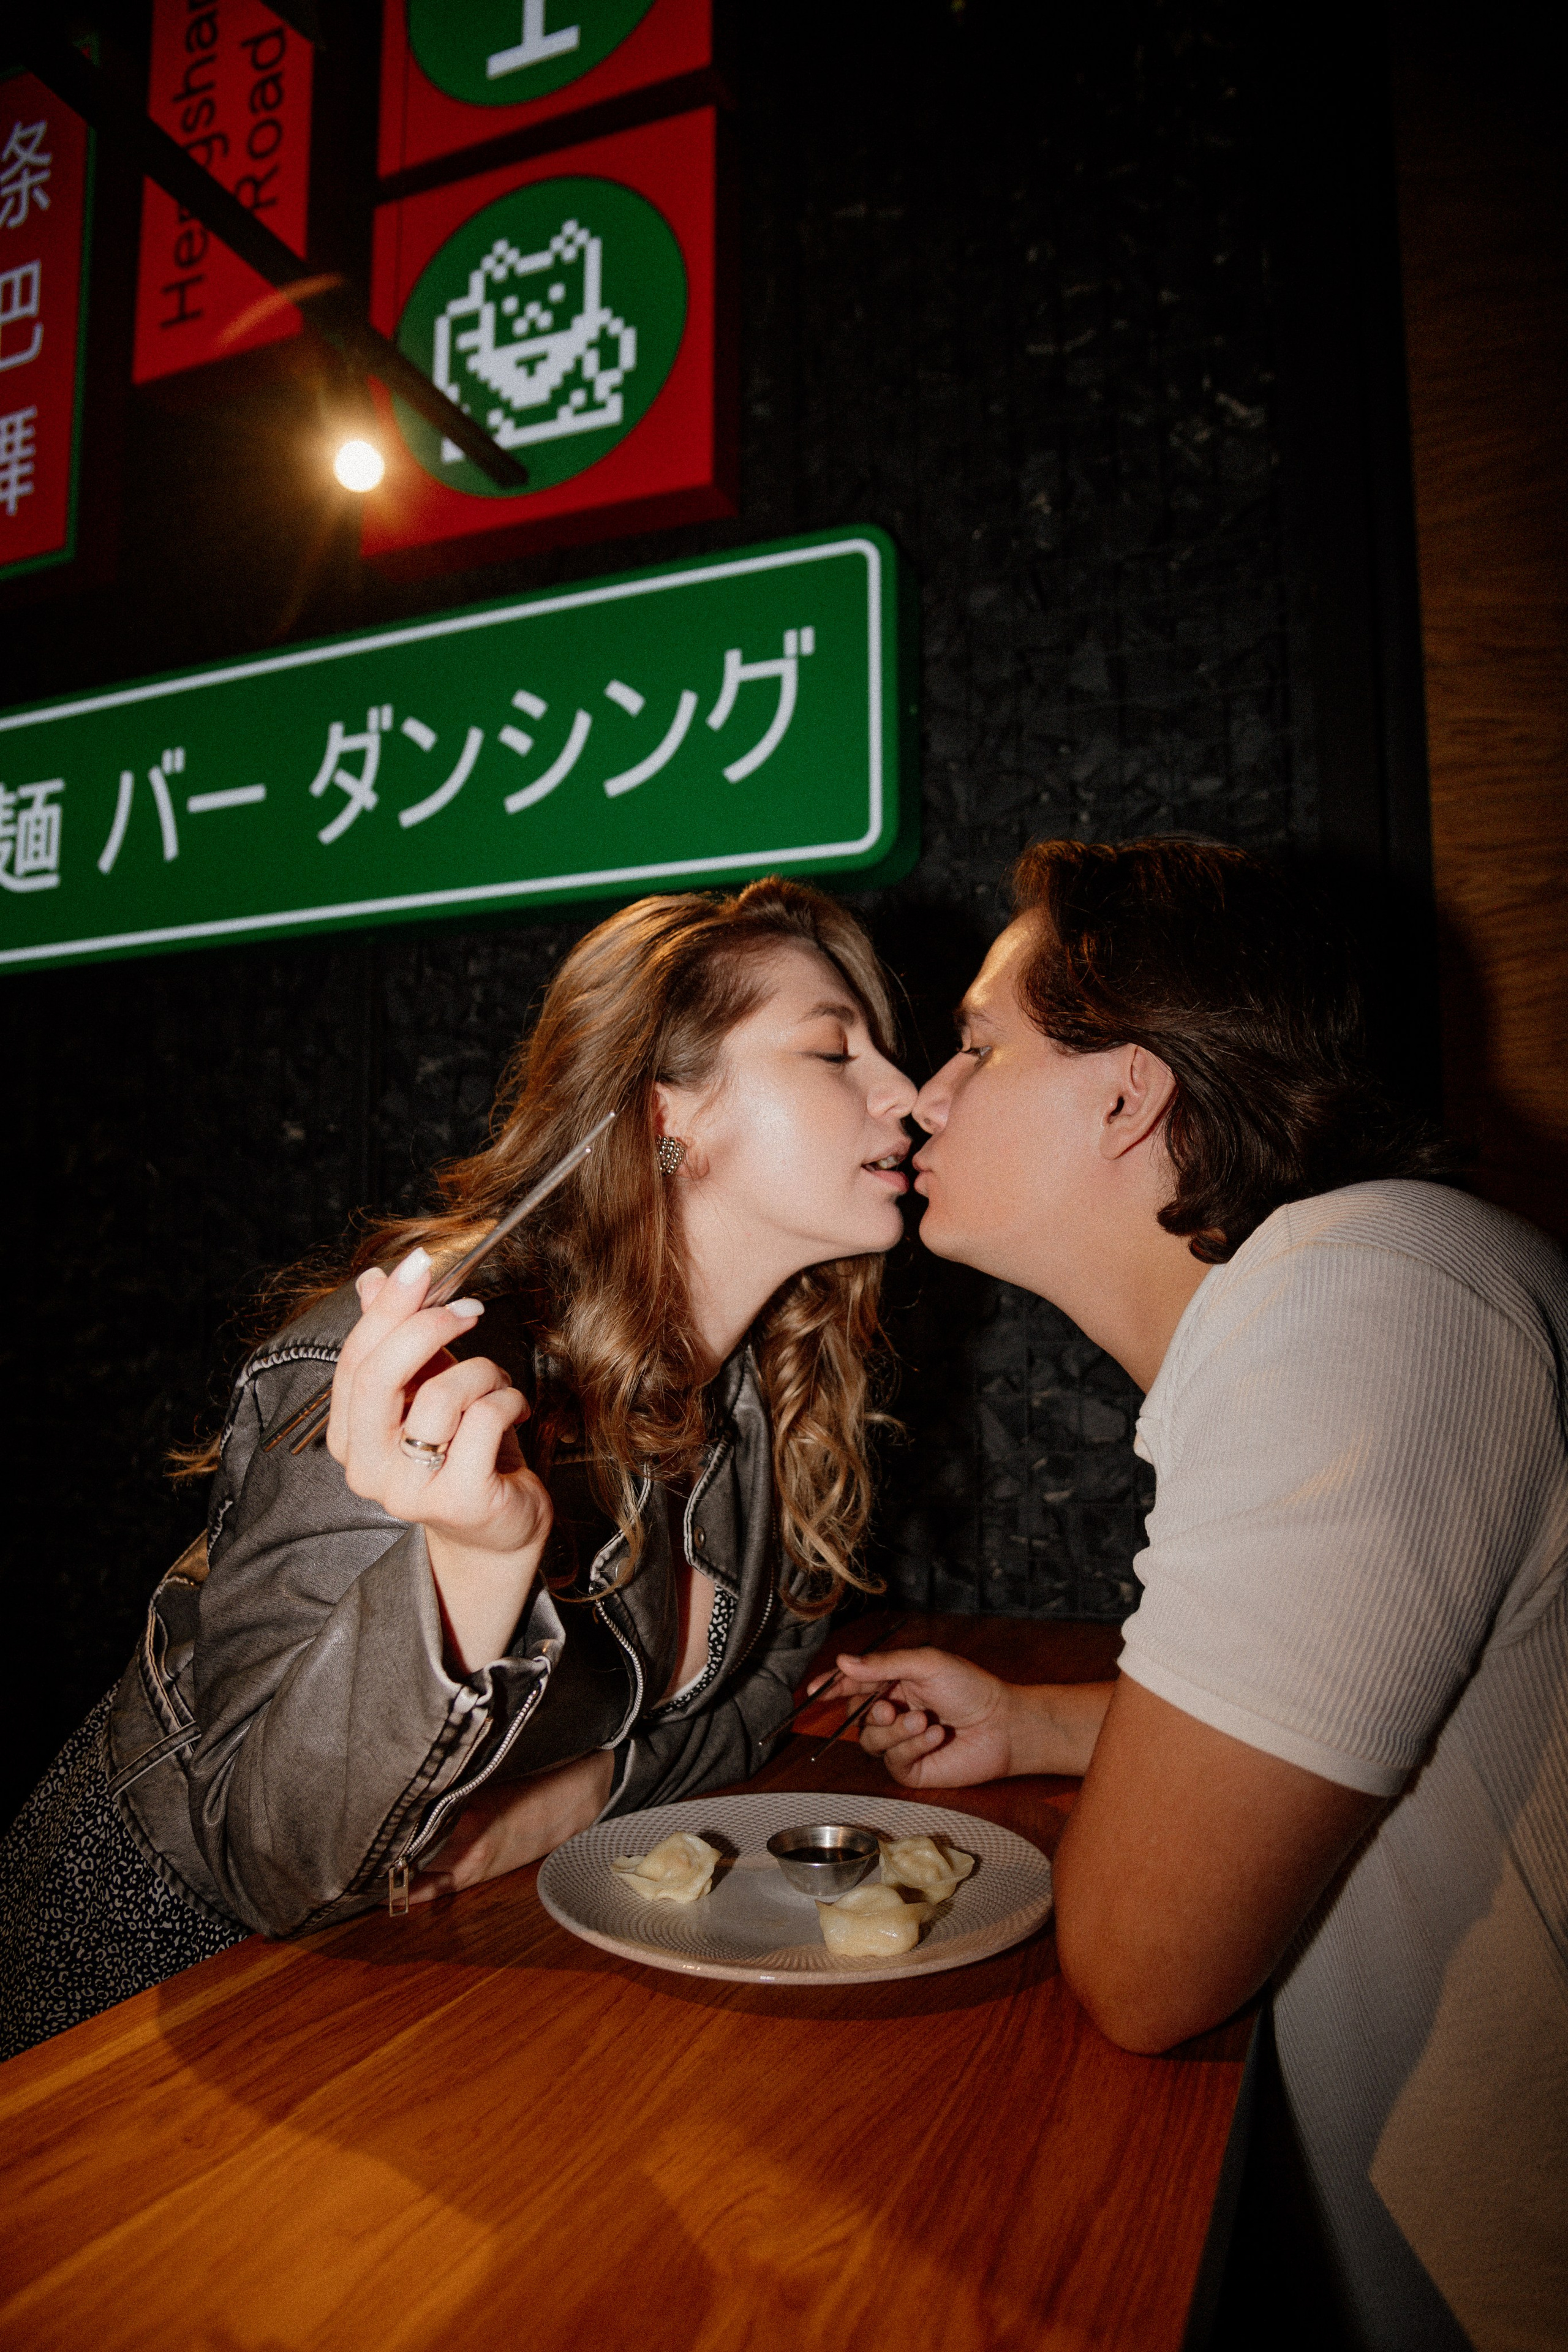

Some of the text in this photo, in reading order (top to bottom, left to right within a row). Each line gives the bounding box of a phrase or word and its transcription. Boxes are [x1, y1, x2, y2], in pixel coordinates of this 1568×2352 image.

[161, 0, 228, 328] Hegsha
[233, 26, 286, 213] Road
[97, 747, 266, 873] バー
[309, 626, 815, 845] ダンシング
